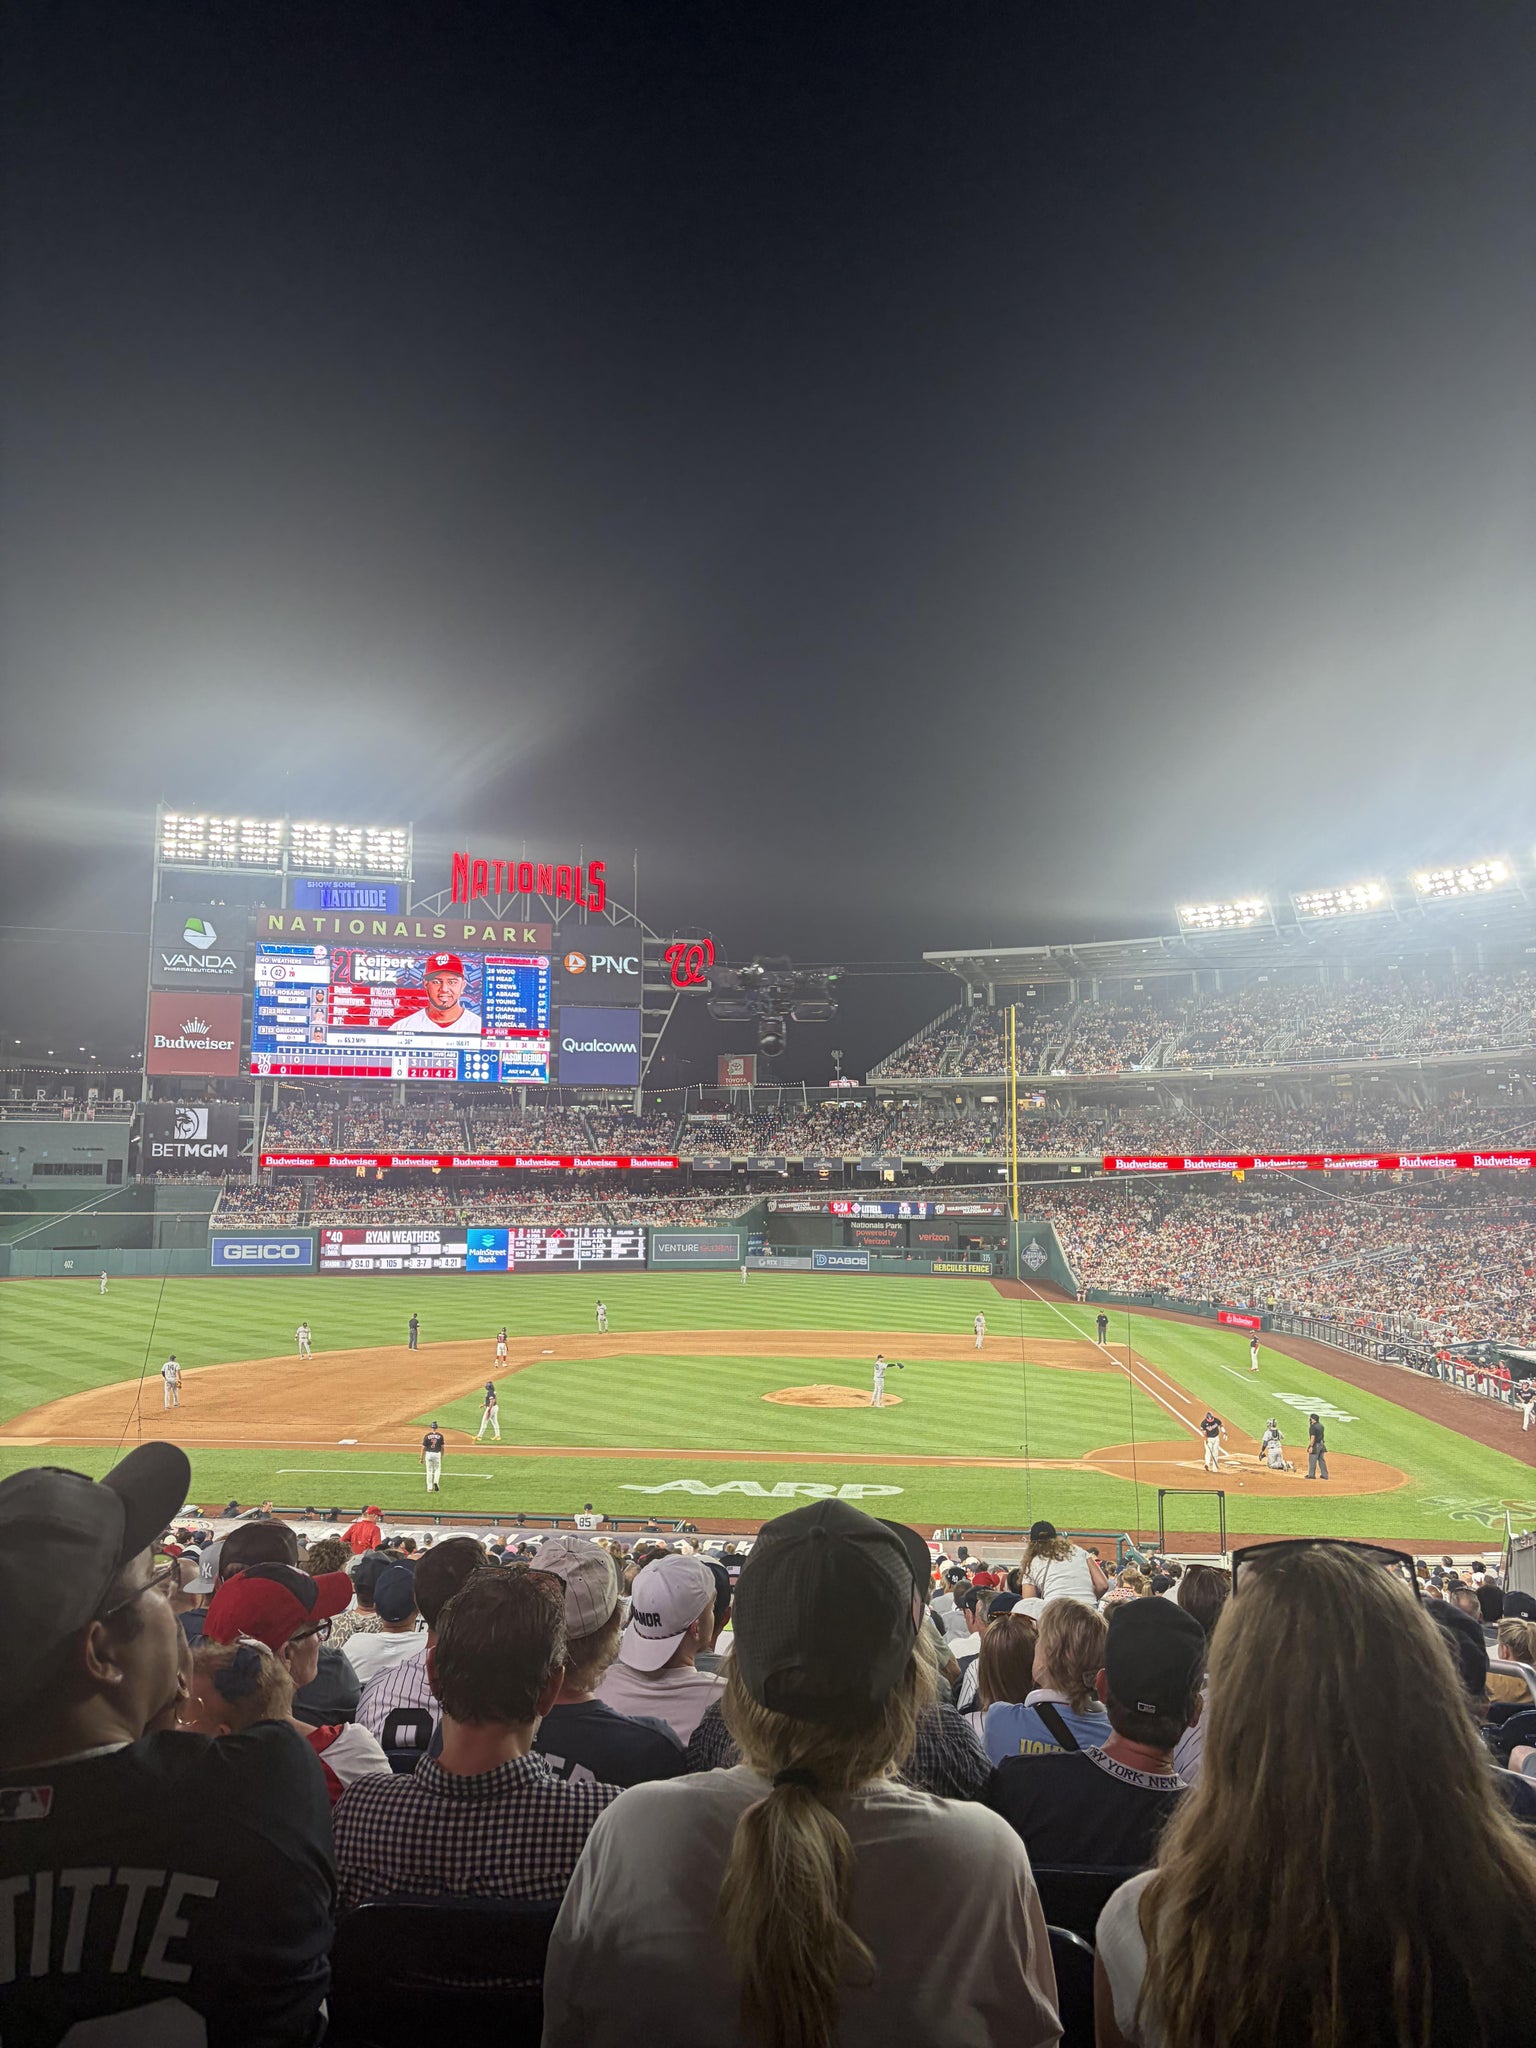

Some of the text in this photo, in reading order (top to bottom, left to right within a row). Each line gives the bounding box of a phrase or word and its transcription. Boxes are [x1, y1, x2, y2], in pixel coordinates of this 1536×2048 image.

[452, 852, 606, 912] NATIONALS
[321, 889, 386, 908] NATITUDE
[268, 915, 537, 943] NATIONALS PARK
[161, 953, 237, 969] VANDA
[271, 957, 302, 965] WEATHERS
[355, 954, 415, 968] Keibert
[590, 955, 639, 974] PNC
[354, 966, 397, 982] Ruiz
[154, 1035, 235, 1050] Budweiser
[562, 1038, 637, 1053] Qualcomm
[152, 1143, 228, 1158] BETMGM
[265, 1156, 314, 1166] Budweiser
[329, 1157, 378, 1166] Budweiser
[391, 1157, 439, 1166] Budweiser
[452, 1157, 499, 1166] Budweiser
[515, 1157, 560, 1166] Budweiser
[573, 1158, 618, 1167] Budweiser
[630, 1158, 674, 1167] Budweiser
[1115, 1159, 1168, 1169] Budweiser
[1184, 1158, 1238, 1169] Budweiser
[1399, 1156, 1457, 1168] Budweiser
[1473, 1155, 1532, 1167] Budweiser
[833, 1202, 849, 1212] 9:24
[851, 1221, 884, 1229] Nationals
[326, 1231, 343, 1243] #40
[365, 1230, 441, 1243] RYAN WEATHERS
[855, 1230, 897, 1238] powered by
[918, 1232, 950, 1242] verizon
[223, 1244, 300, 1259] GEICO
[469, 1248, 507, 1257] MainStreet
[658, 1243, 699, 1252] VENTURE
[386, 1259, 398, 1267] 105
[828, 1257, 867, 1265] DABOS
[933, 1264, 990, 1273] HERCULES FENCE
[618, 1479, 905, 1499] AARP
[579, 1517, 592, 1528] 85
[1108, 1757, 1179, 1789] YORK NEW
